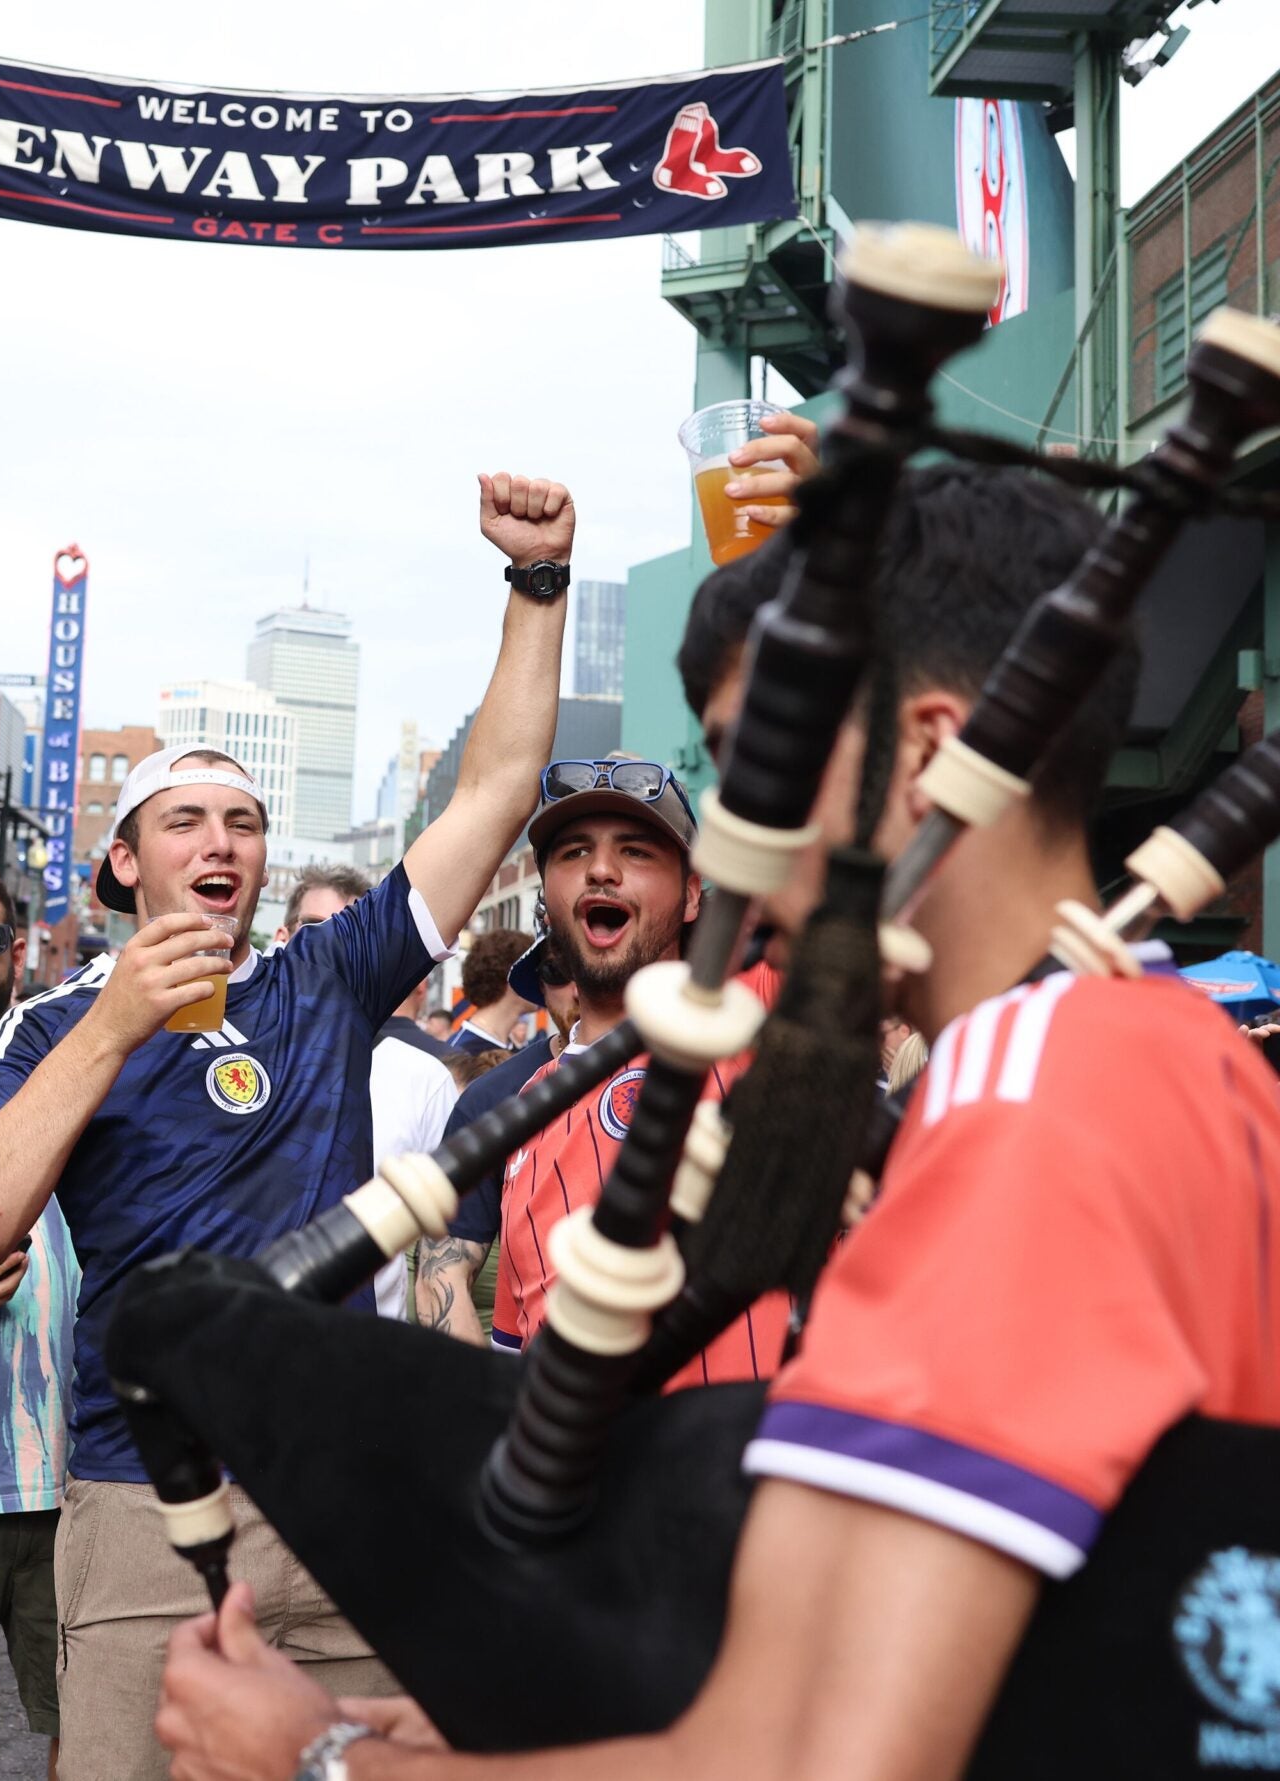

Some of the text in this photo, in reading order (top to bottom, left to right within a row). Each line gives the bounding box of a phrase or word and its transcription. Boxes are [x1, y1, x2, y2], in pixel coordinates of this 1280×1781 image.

[138, 95, 413, 134] WELCOME TO
[346, 141, 621, 206] PARK
[192, 217, 343, 246] GATE C
[52, 592, 81, 720] HOUSE
[48, 732, 72, 748] of
[43, 760, 70, 892] BLUES
